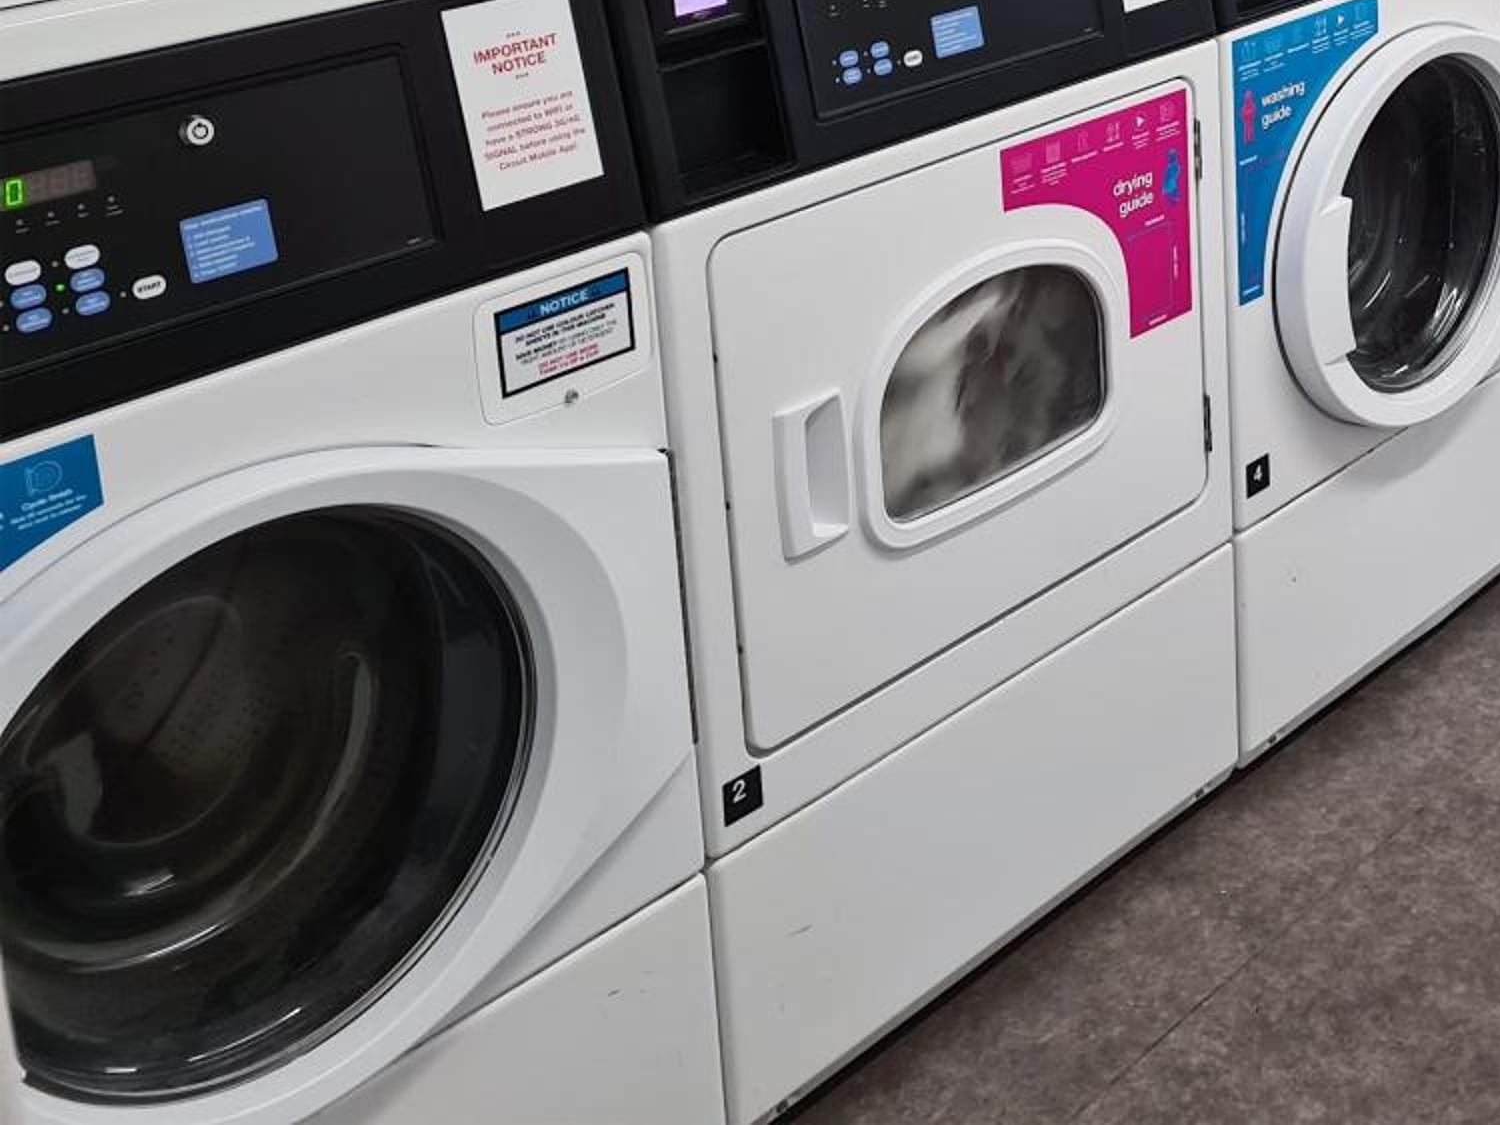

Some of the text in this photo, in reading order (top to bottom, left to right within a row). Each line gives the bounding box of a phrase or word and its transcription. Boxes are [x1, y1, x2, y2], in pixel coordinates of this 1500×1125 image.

[474, 33, 558, 65] IMPORTANT
[491, 50, 547, 75] NOTICE
[1261, 78, 1306, 130] washing guide
[1113, 171, 1154, 219] drying guide
[539, 288, 589, 316] NOTICE
[732, 779, 747, 804] 2
